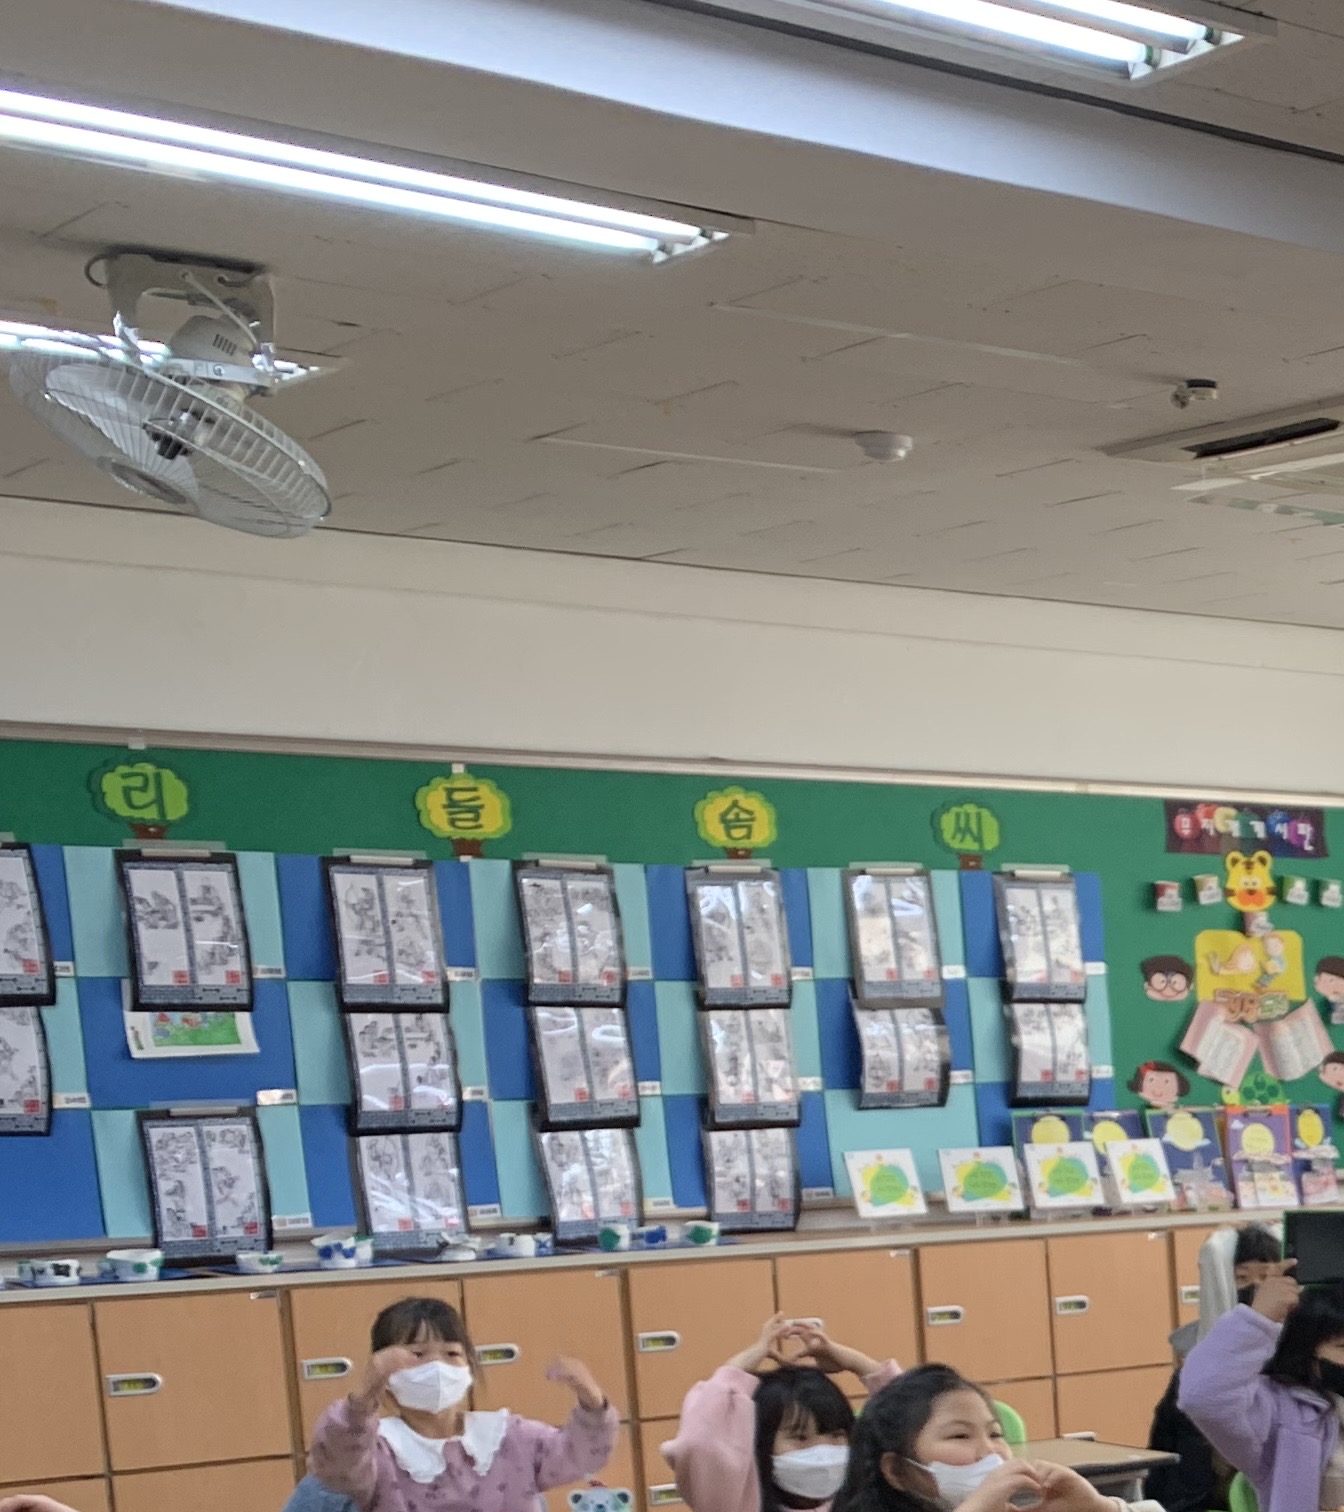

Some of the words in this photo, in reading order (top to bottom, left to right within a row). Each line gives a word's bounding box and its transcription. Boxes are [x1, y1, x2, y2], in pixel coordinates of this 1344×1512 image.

[120, 771, 167, 820] 리
[441, 786, 485, 830] 들
[720, 799, 756, 841] 솜
[951, 811, 985, 848] 씨
